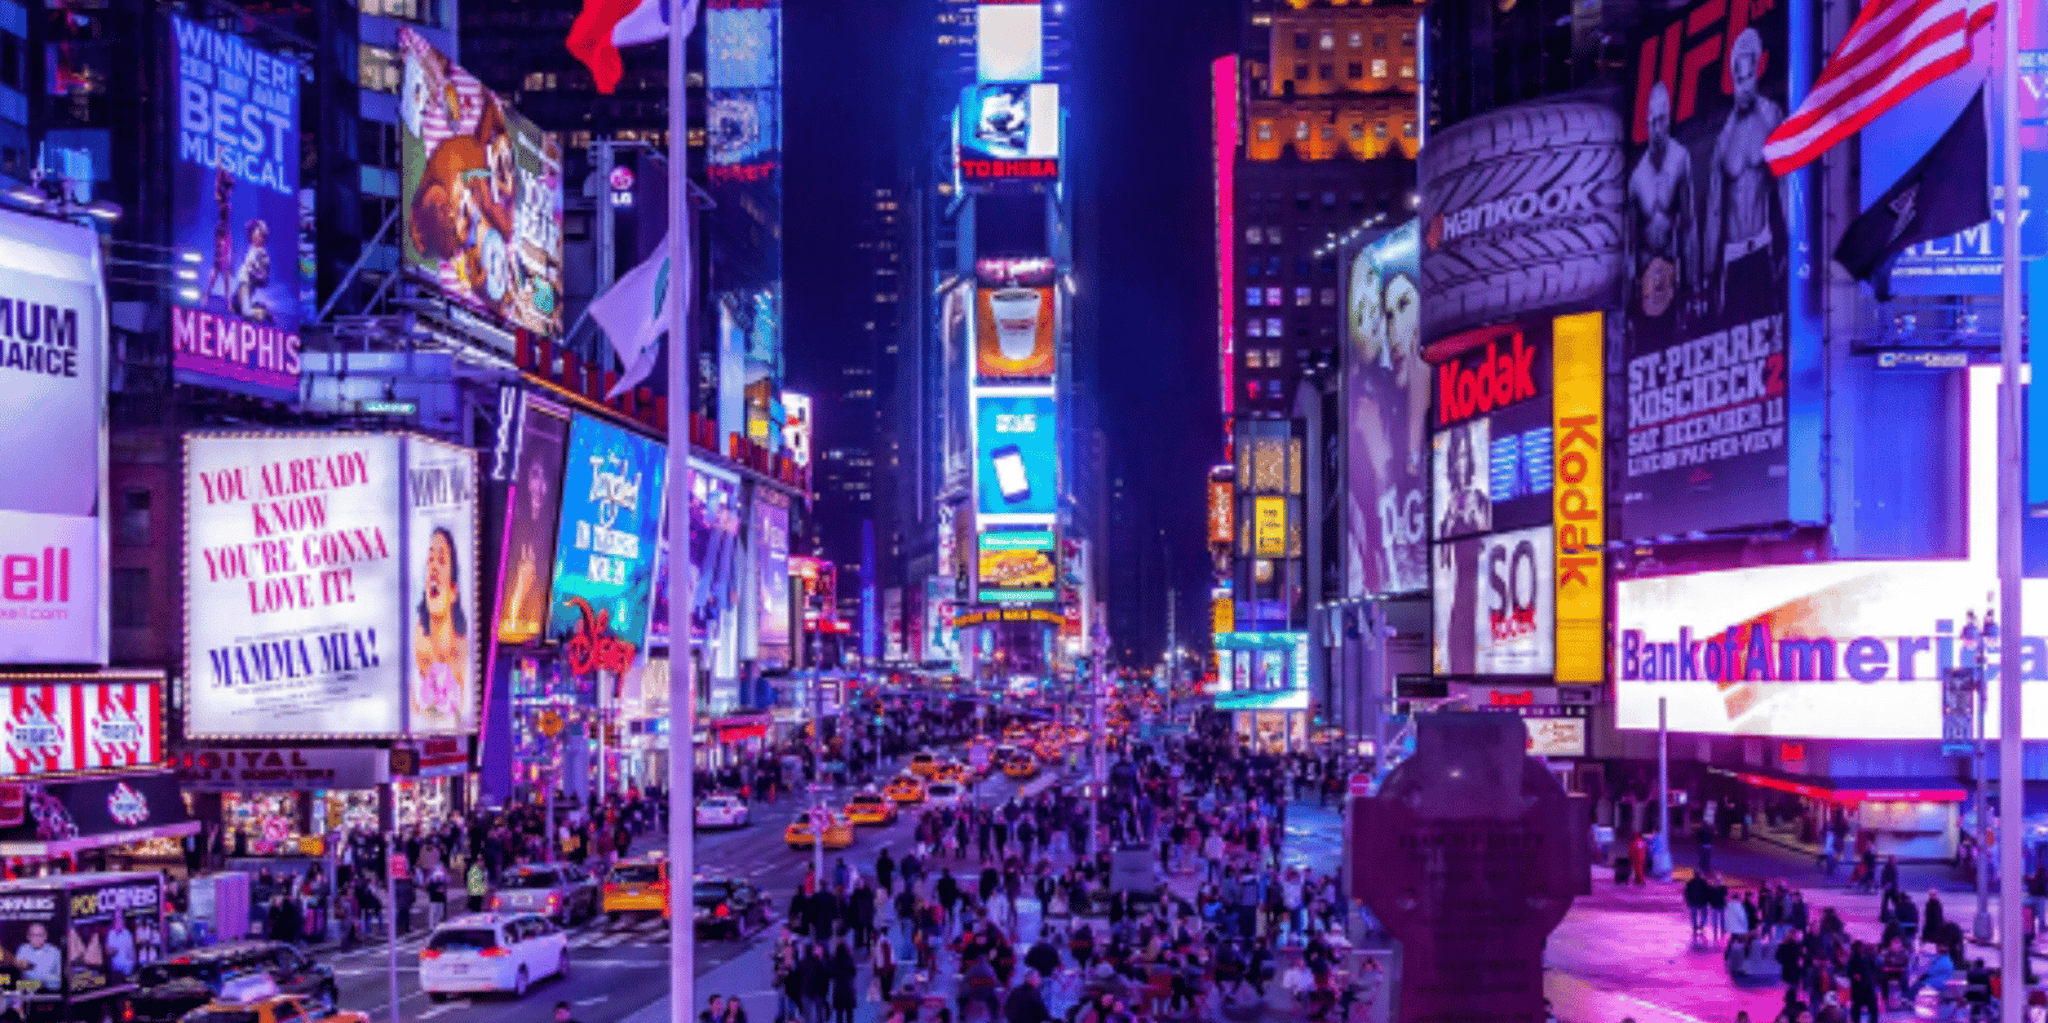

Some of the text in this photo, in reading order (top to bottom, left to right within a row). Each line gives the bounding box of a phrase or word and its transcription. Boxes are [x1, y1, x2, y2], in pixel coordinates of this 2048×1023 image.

[172, 14, 296, 94] WINNER!
[181, 79, 291, 162] BEST
[181, 131, 293, 195] MUSICAL
[962, 160, 1057, 178] TOSHIBA
[0, 339, 78, 378] ANCE
[173, 305, 301, 374] MEMPHIS
[1439, 331, 1538, 425] Kodak
[1628, 428, 1659, 456] SAT
[1663, 403, 1762, 448] DECEMBER
[200, 465, 248, 505] YOU
[260, 449, 370, 498] ALREADY
[1558, 414, 1600, 589] Kodak
[251, 493, 328, 538] KNOW
[203, 526, 389, 582] YOU'RE GONNA
[1488, 540, 1538, 622] SO
[248, 567, 355, 615] LOVE IT!
[209, 638, 313, 688] MAMMA
[318, 626, 380, 674] MIA!
